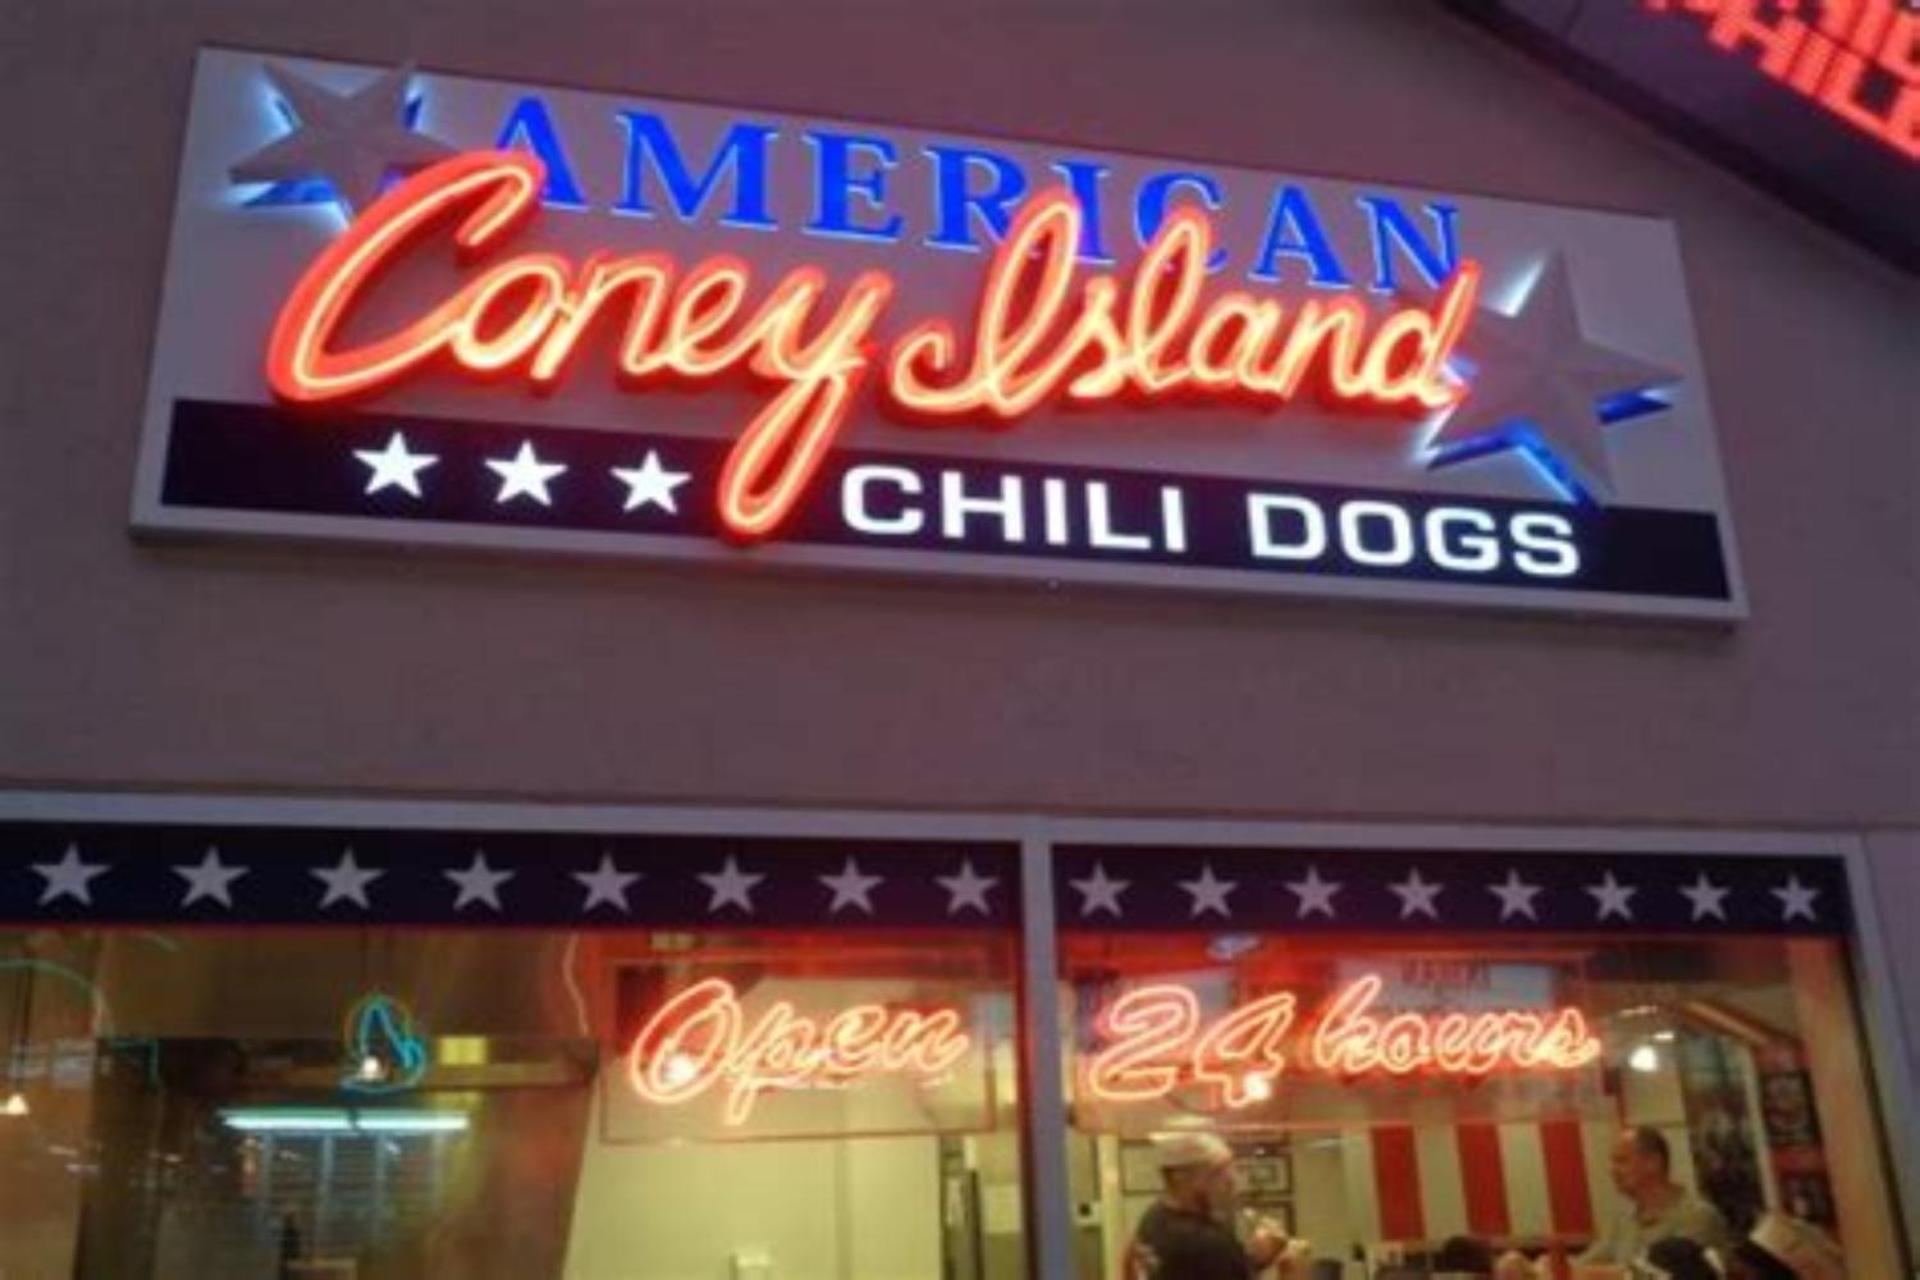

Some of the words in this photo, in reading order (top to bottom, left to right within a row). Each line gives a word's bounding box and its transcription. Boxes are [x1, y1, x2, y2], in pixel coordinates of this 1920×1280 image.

[490, 94, 1463, 292] AMERICAN
[266, 149, 892, 537] Coney
[887, 188, 1480, 417] Island
[841, 464, 1189, 553] CHILI
[1247, 493, 1581, 577] DOGS
[630, 977, 969, 1126] Open
[1089, 984, 1297, 1108] 24
[1312, 974, 1602, 1074] hours
